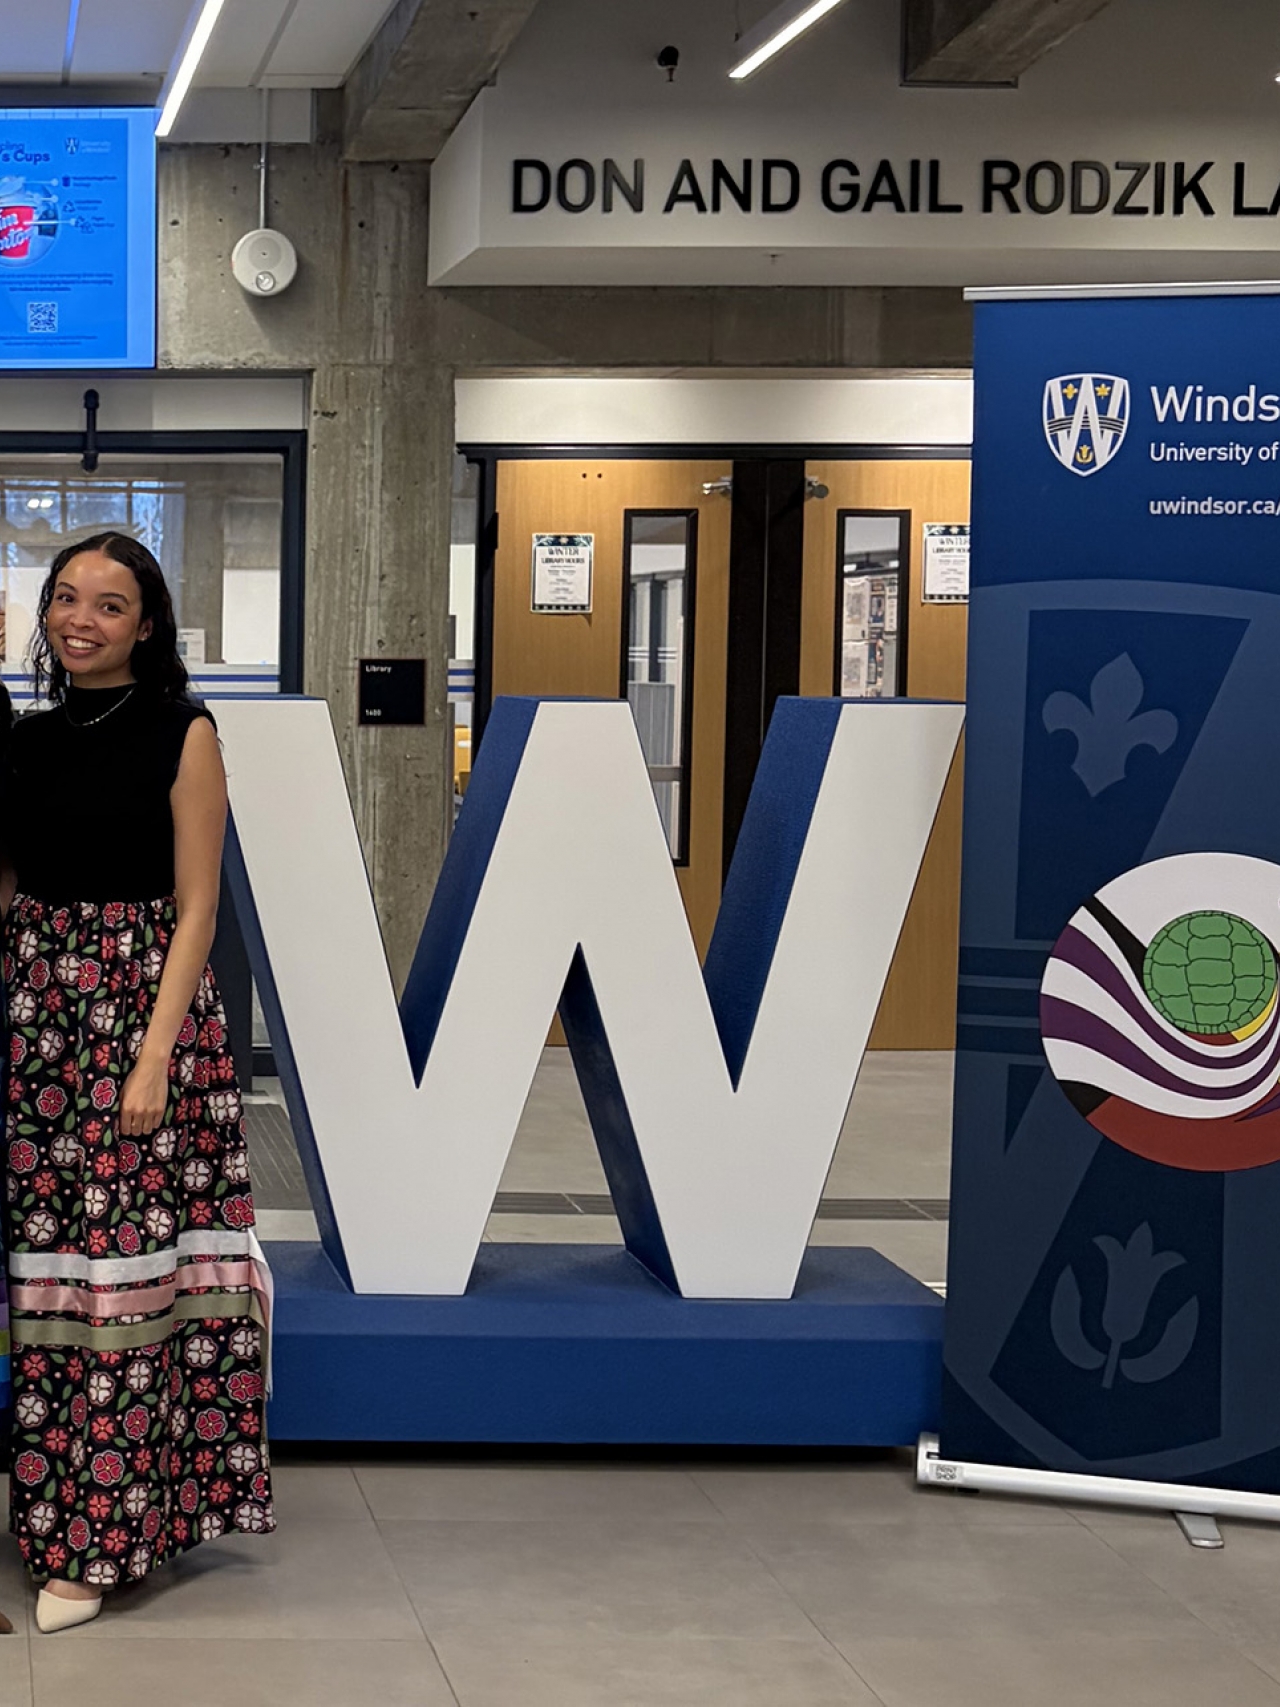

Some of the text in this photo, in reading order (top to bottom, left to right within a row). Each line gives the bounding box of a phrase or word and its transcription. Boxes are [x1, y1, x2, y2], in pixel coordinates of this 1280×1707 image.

[13, 149, 51, 166] Cups
[512, 158, 1280, 216] DON AND GAIL RODZIK L
[1150, 385, 1280, 423] Winds
[1150, 442, 1280, 465] University of
[365, 665, 392, 673] Library
